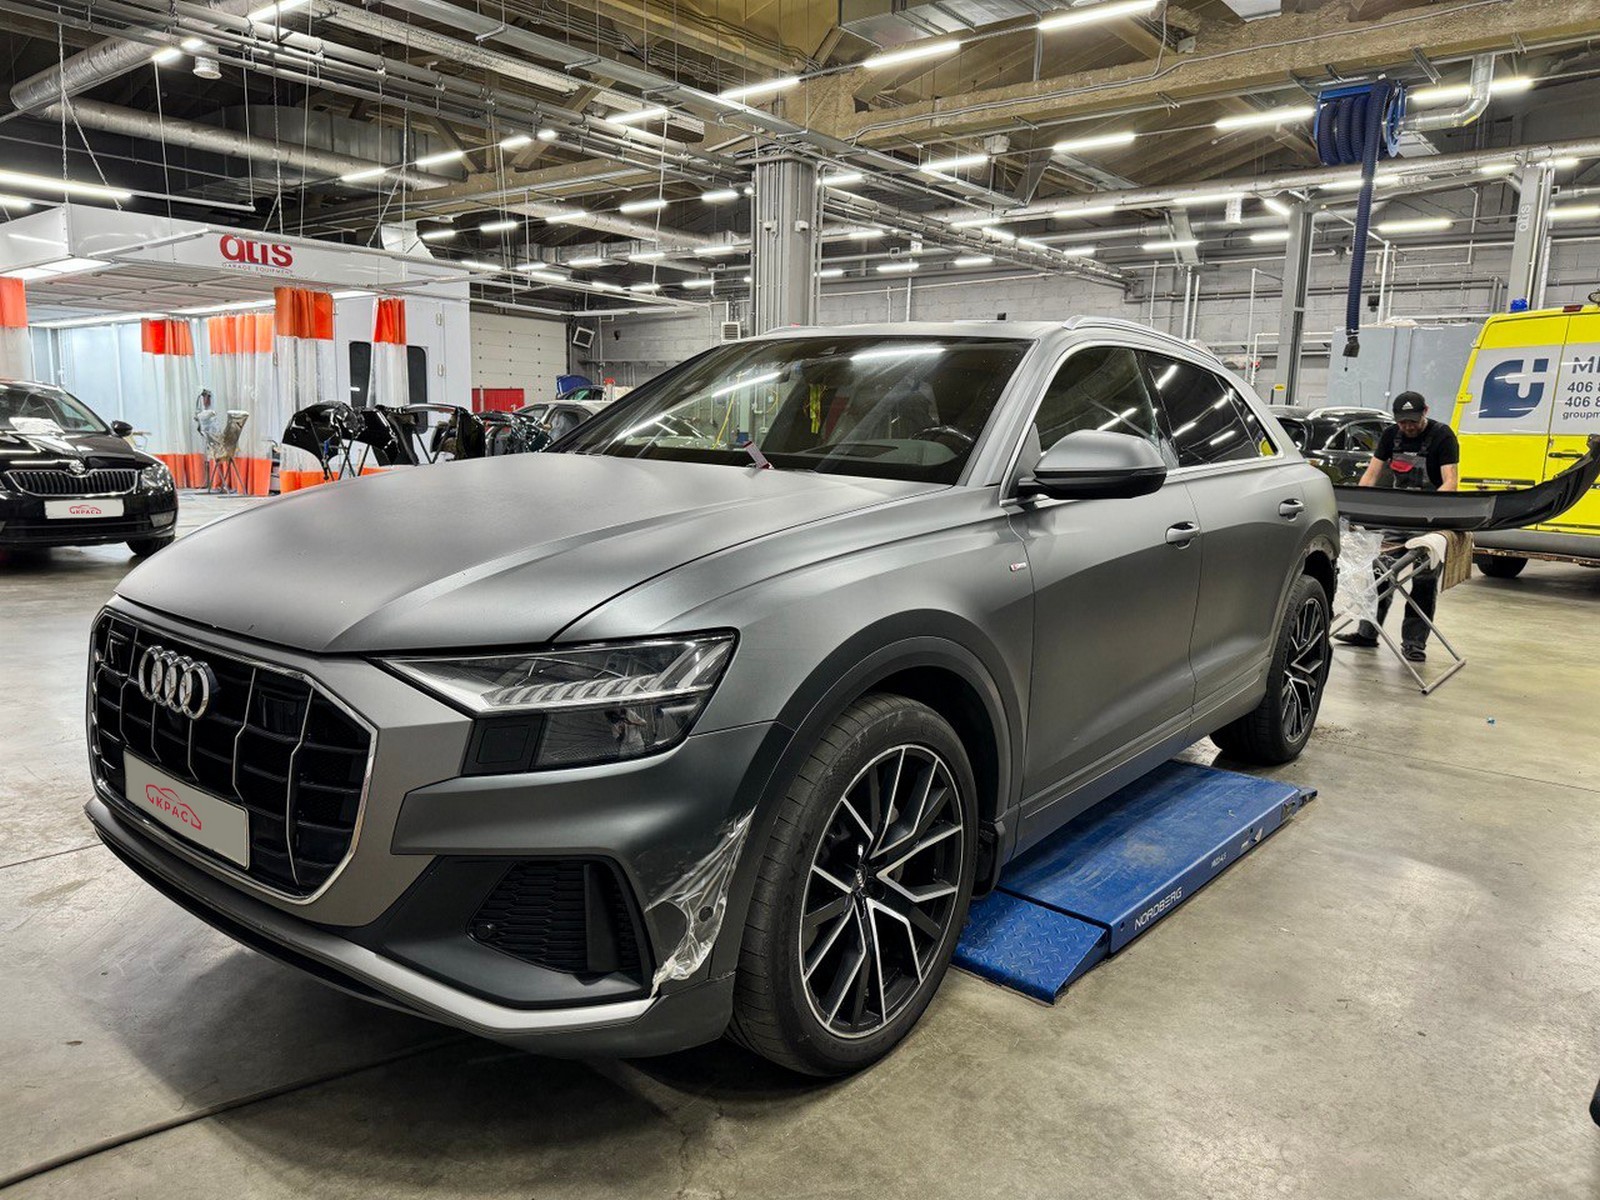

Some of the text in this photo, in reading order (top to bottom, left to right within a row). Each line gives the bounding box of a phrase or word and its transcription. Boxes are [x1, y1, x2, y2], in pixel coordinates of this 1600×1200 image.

[1567, 381, 1593, 393] 406
[1565, 396, 1590, 407] 406
[1134, 886, 1183, 931] NORDBERG
